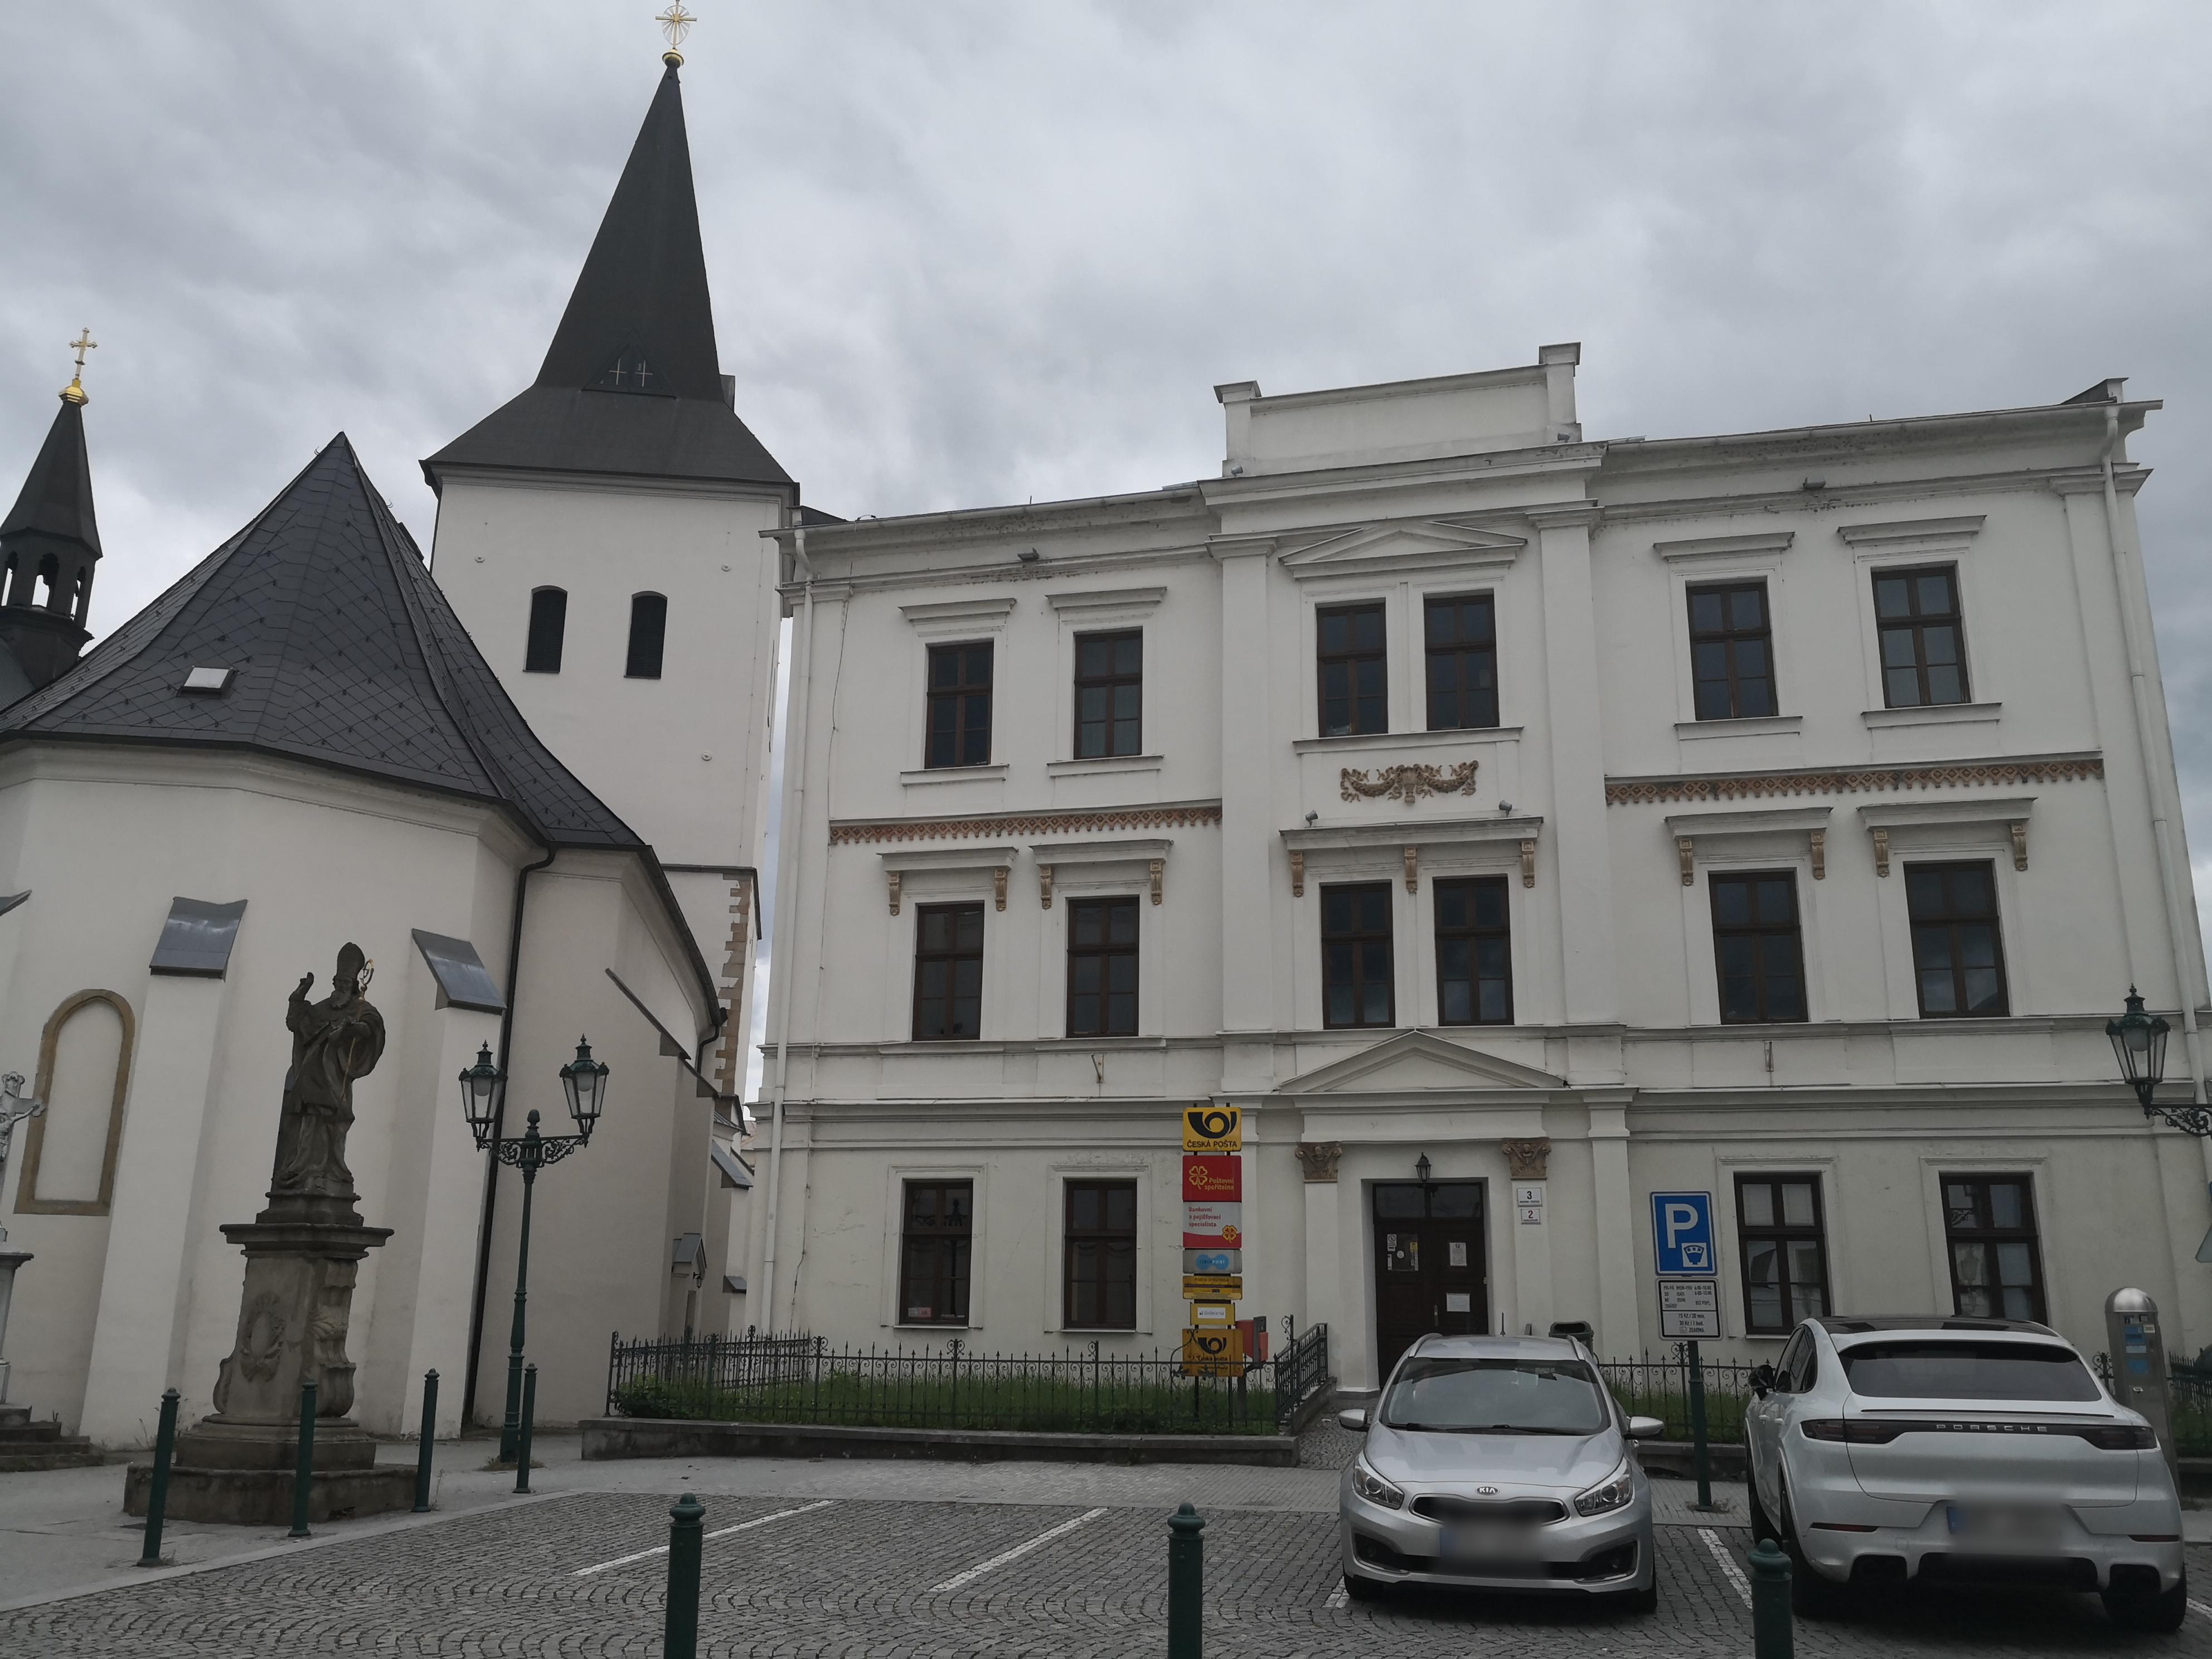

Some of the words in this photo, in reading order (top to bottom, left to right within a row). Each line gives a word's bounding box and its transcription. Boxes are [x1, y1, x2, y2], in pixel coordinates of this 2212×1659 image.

[1527, 1191, 1532, 1199] 3
[1528, 1210, 1534, 1219] 2
[1665, 1204, 1698, 1248] P
[1936, 1424, 2048, 1432] PORSCHE
